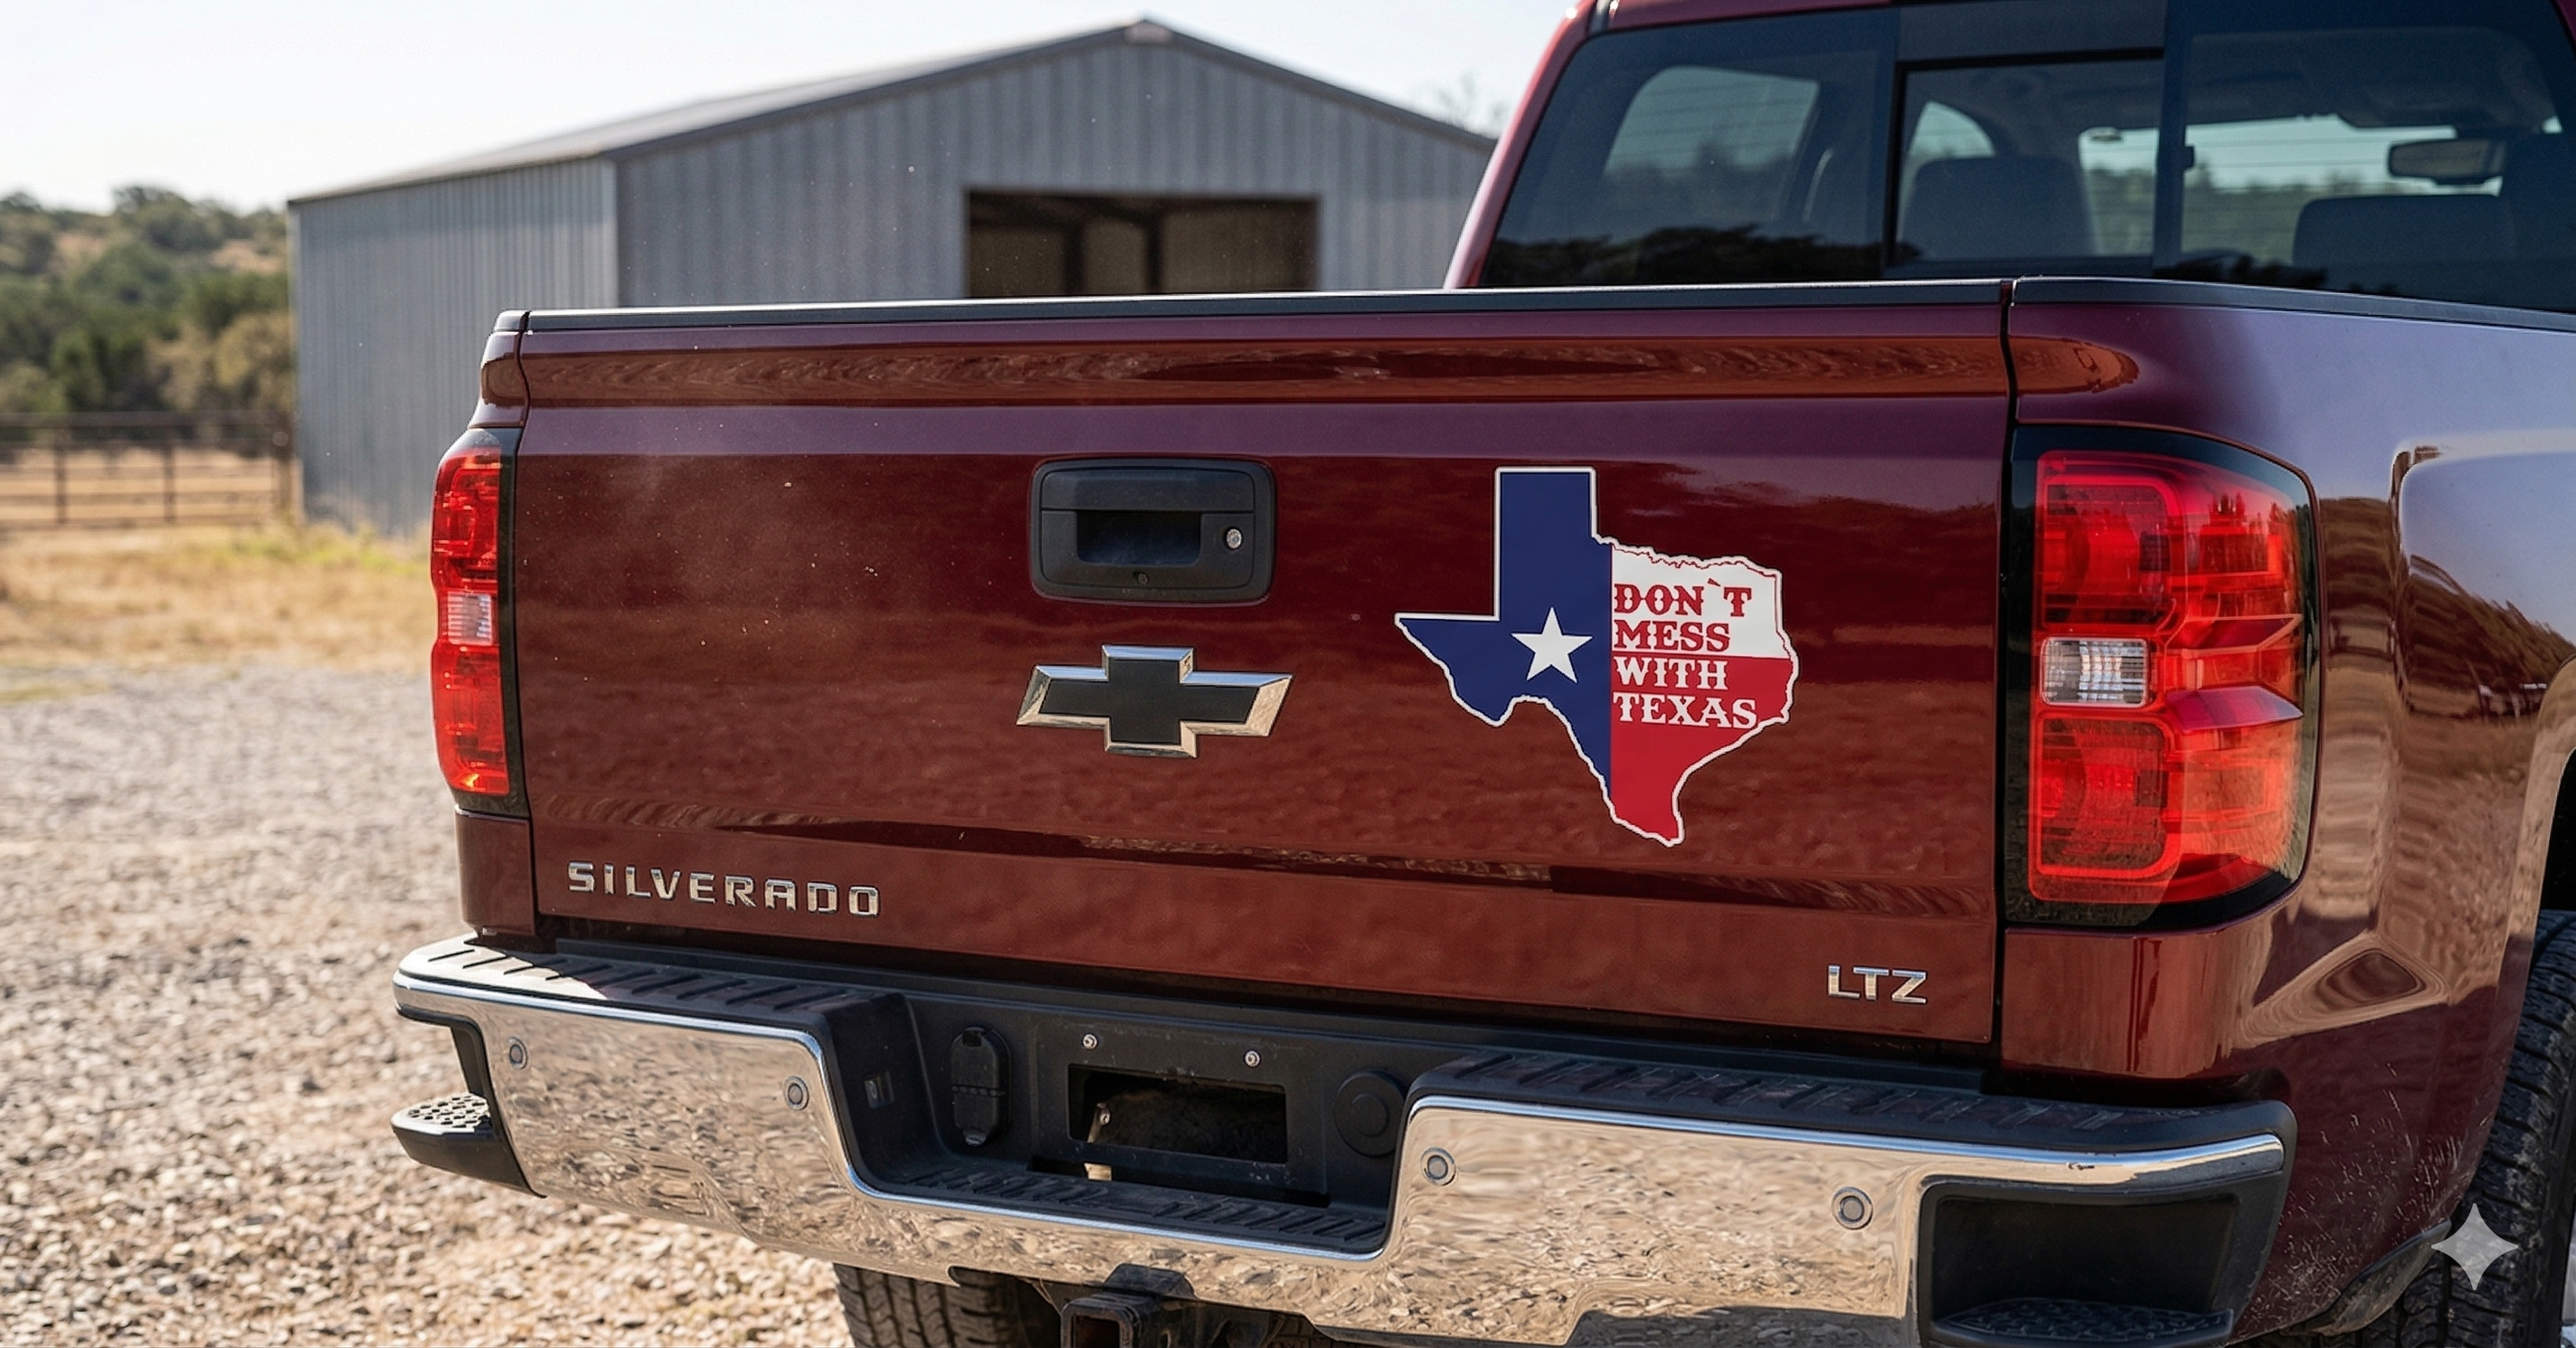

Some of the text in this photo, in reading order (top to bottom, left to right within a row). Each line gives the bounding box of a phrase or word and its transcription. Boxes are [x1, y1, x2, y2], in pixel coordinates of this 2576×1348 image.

[1614, 620, 1730, 652] MESS
[1614, 657, 1728, 690] WITH
[1613, 693, 1757, 729] TEXAS
[567, 860, 880, 917] SILVERADO
[1828, 964, 1927, 1004] LTZ
